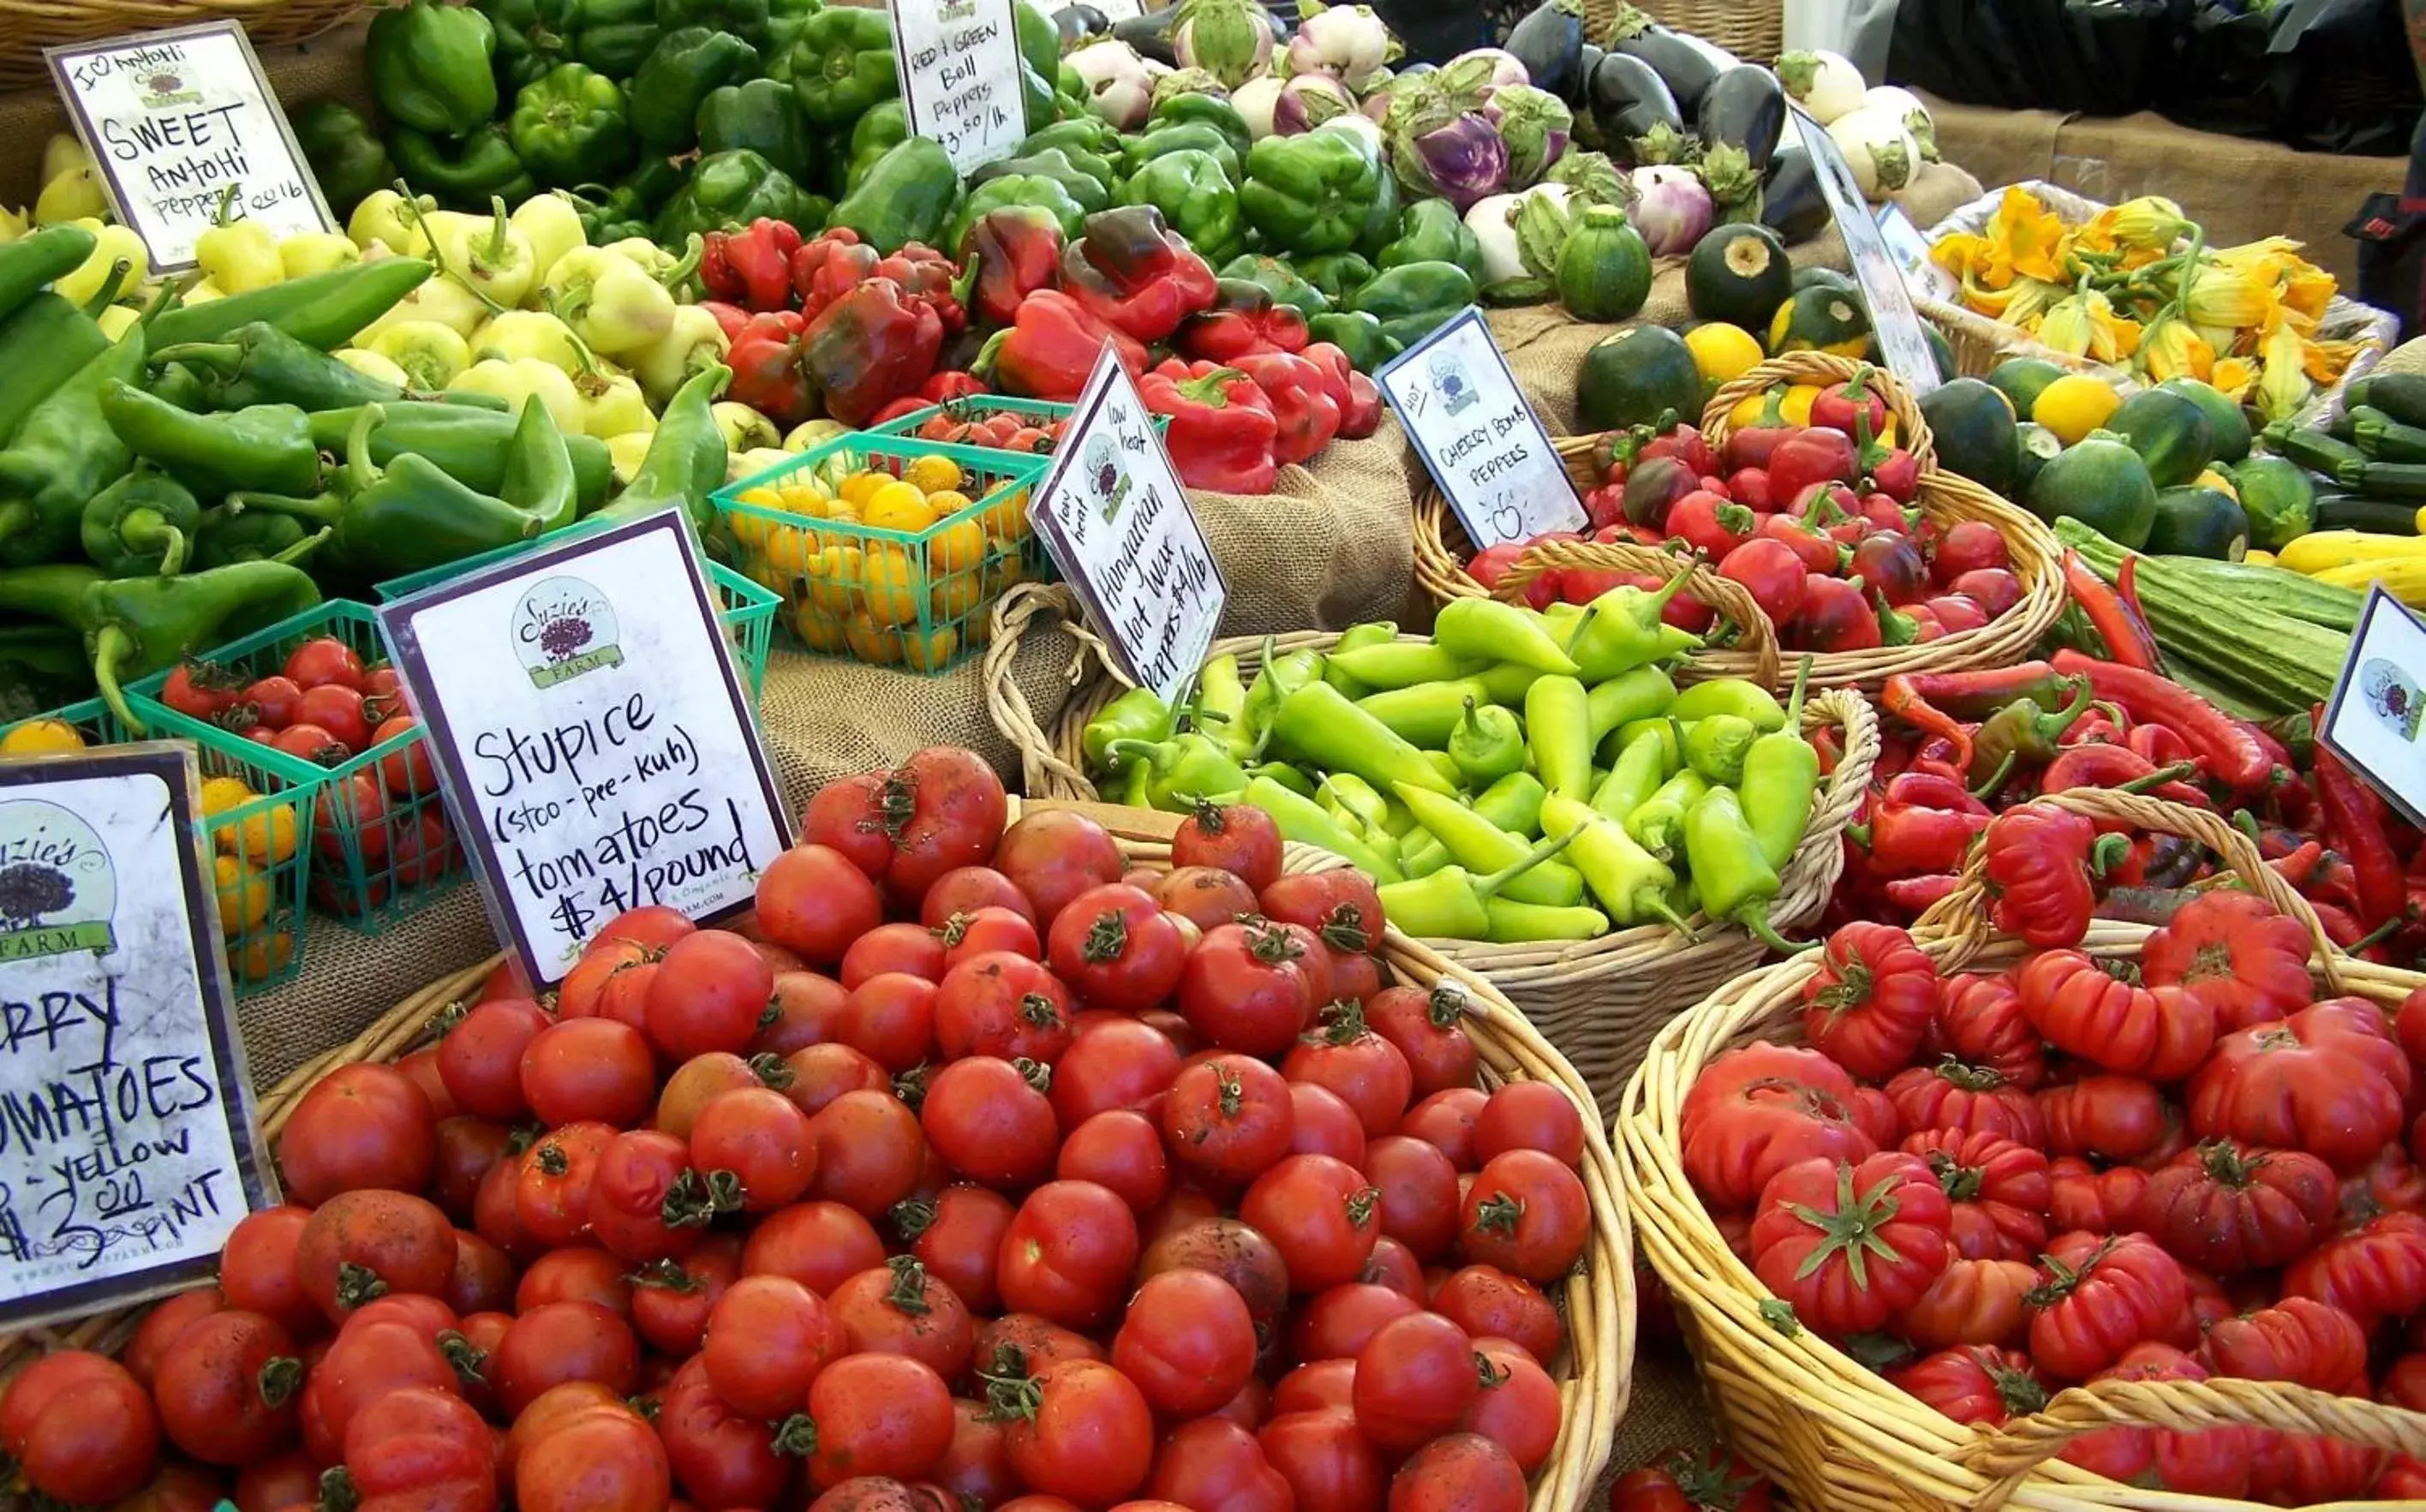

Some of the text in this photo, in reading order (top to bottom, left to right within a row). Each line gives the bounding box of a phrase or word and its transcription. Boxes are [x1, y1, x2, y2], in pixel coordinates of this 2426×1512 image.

[911, 47, 938, 75] RED
[954, 20, 998, 52] GREEN
[104, 102, 245, 161] SWEET
[1405, 381, 1422, 411] HOT
[1117, 424, 1147, 456] heat
[1439, 404, 1527, 468] CHERRY BOMB
[1469, 443, 1528, 487] PEPPERS
[1096, 482, 1164, 613] Hungarian
[520, 590, 589, 643] Suzie's
[1120, 535, 1175, 662] Hot Wax
[552, 654, 600, 680] FARM
[475, 692, 655, 797] Stupice
[513, 787, 709, 899] tomatoes
[0, 930, 79, 957] FARM
[51, 1127, 189, 1198] YELLOW
[145, 1167, 223, 1250] PINT
